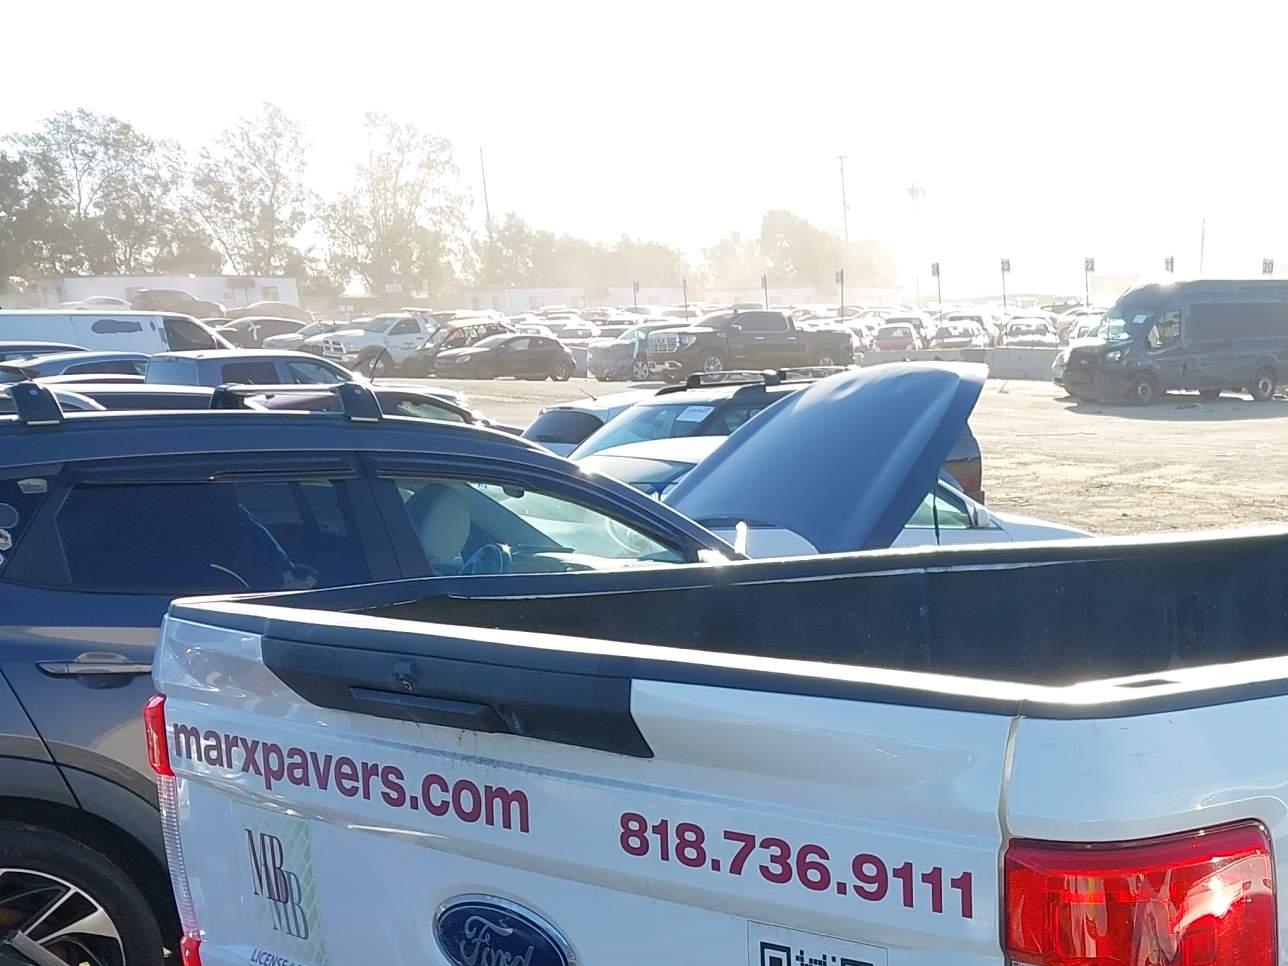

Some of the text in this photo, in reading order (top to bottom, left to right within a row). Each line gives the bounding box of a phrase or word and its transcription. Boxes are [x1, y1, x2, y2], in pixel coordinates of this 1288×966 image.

[1262, 260, 1274, 275] 20
[173, 721, 530, 833] marxpavers.com
[619, 811, 974, 919] 818.736.9111
